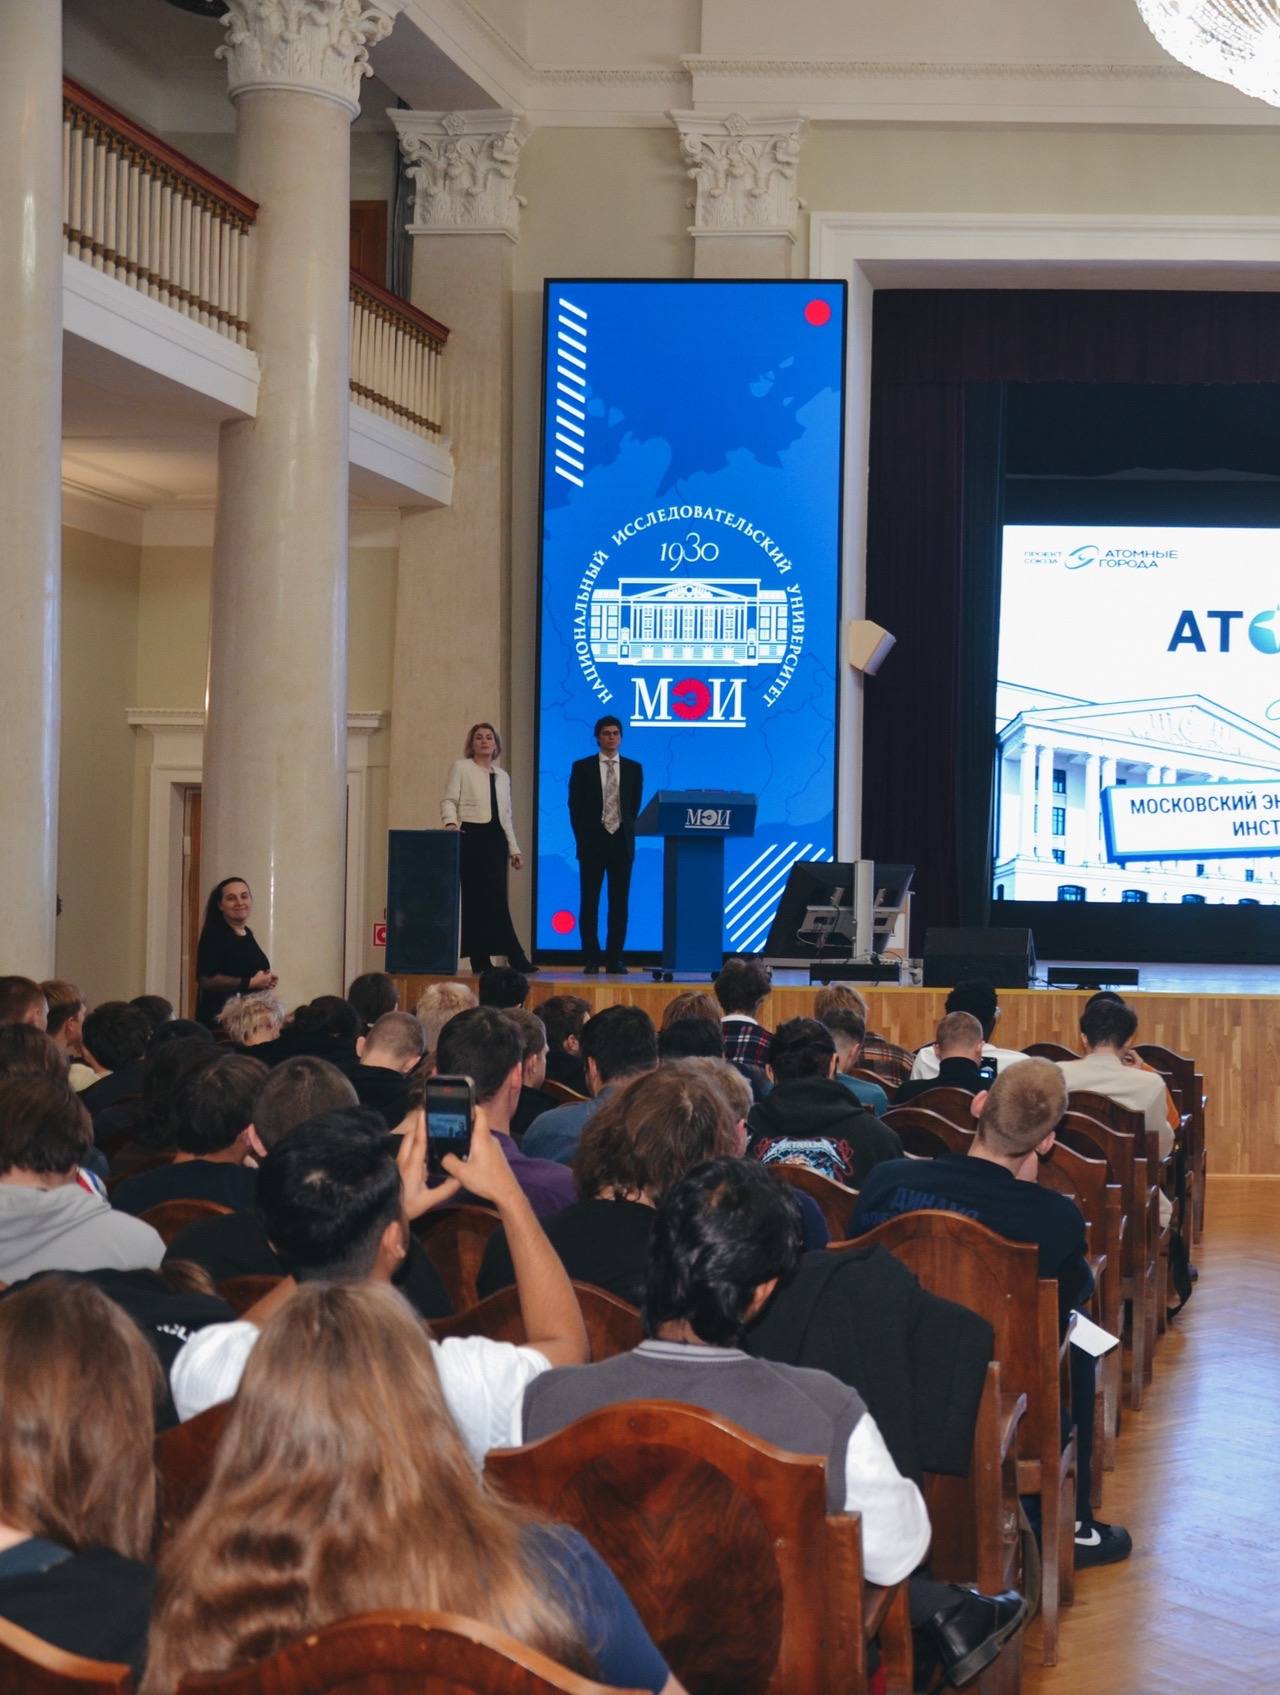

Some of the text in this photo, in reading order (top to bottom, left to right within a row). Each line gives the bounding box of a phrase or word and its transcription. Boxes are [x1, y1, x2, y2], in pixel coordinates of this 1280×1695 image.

[660, 532, 719, 572] 1930
[1099, 559, 1159, 569] ГОРОДА
[1105, 549, 1179, 559] АТОМНЫЕ
[574, 504, 806, 708] НАЦИОНАЛЬНЫЙ ИССЛЕДОВАТЕЛЬСКИЙ УНИВЕРСИТЕТ
[630, 677, 748, 721] МЭИ
[1130, 790, 1258, 815] МОСКОВСКИЙ
[686, 808, 732, 826] МЭИ
